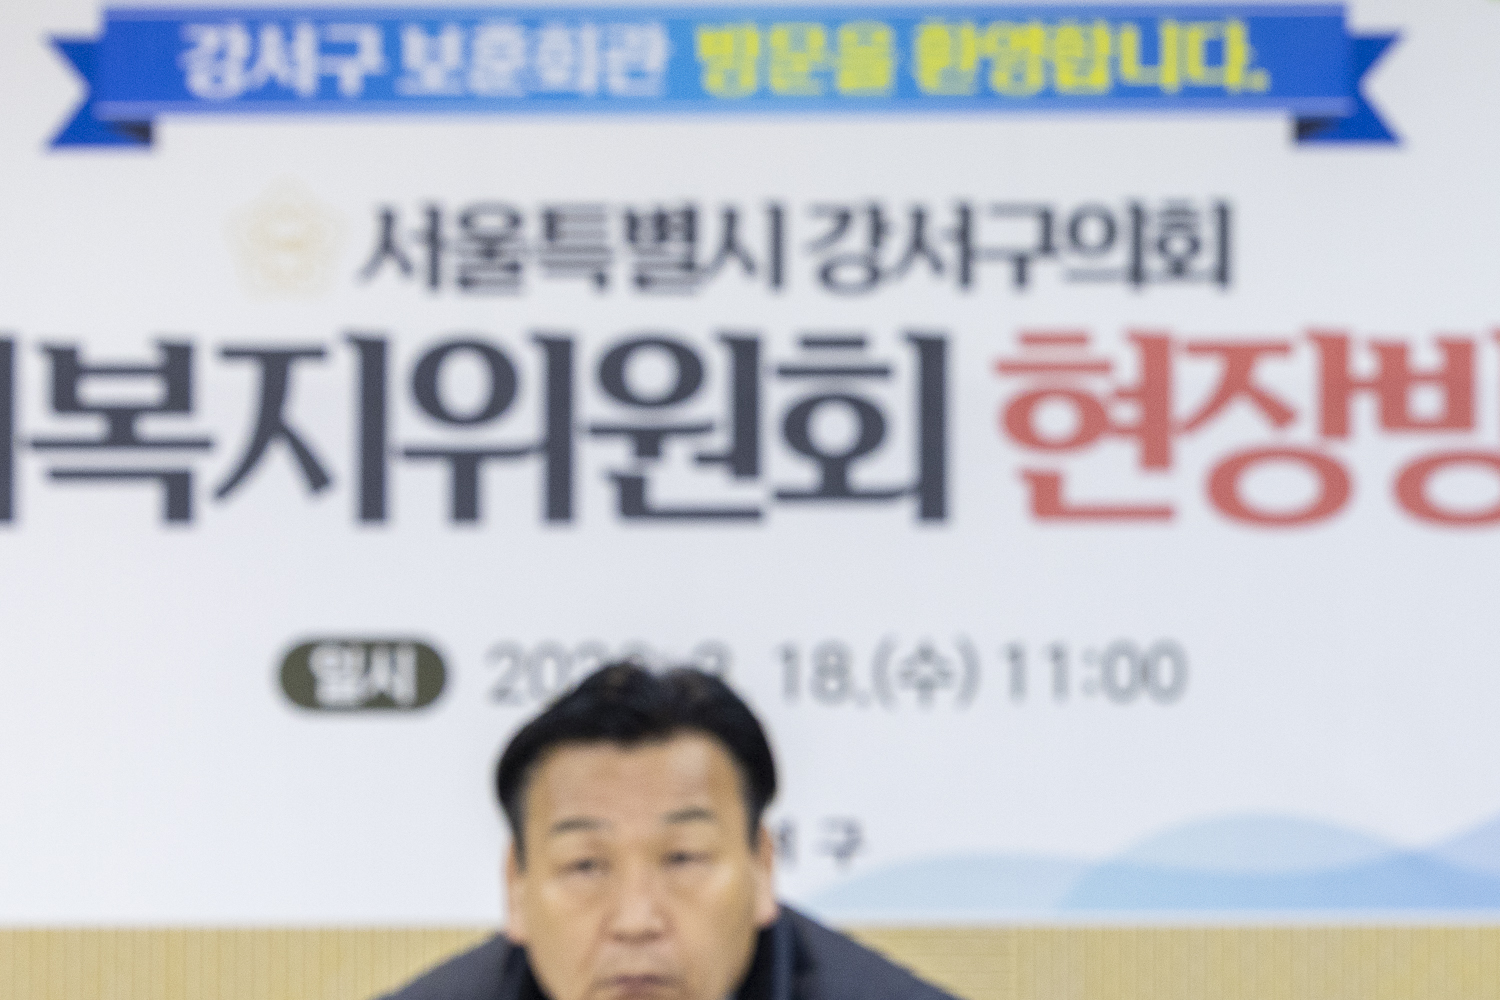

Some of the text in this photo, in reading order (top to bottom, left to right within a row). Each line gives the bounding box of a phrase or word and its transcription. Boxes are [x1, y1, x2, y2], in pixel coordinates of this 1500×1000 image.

[178, 17, 1271, 98] 강서구 보훈회관 방문을 환영합니다.
[362, 199, 1233, 295] 서울특별시 강서구의회
[0, 329, 952, 527] 복지위원회
[306, 645, 418, 706] 일시
[1003, 638, 1189, 705] 11:00
